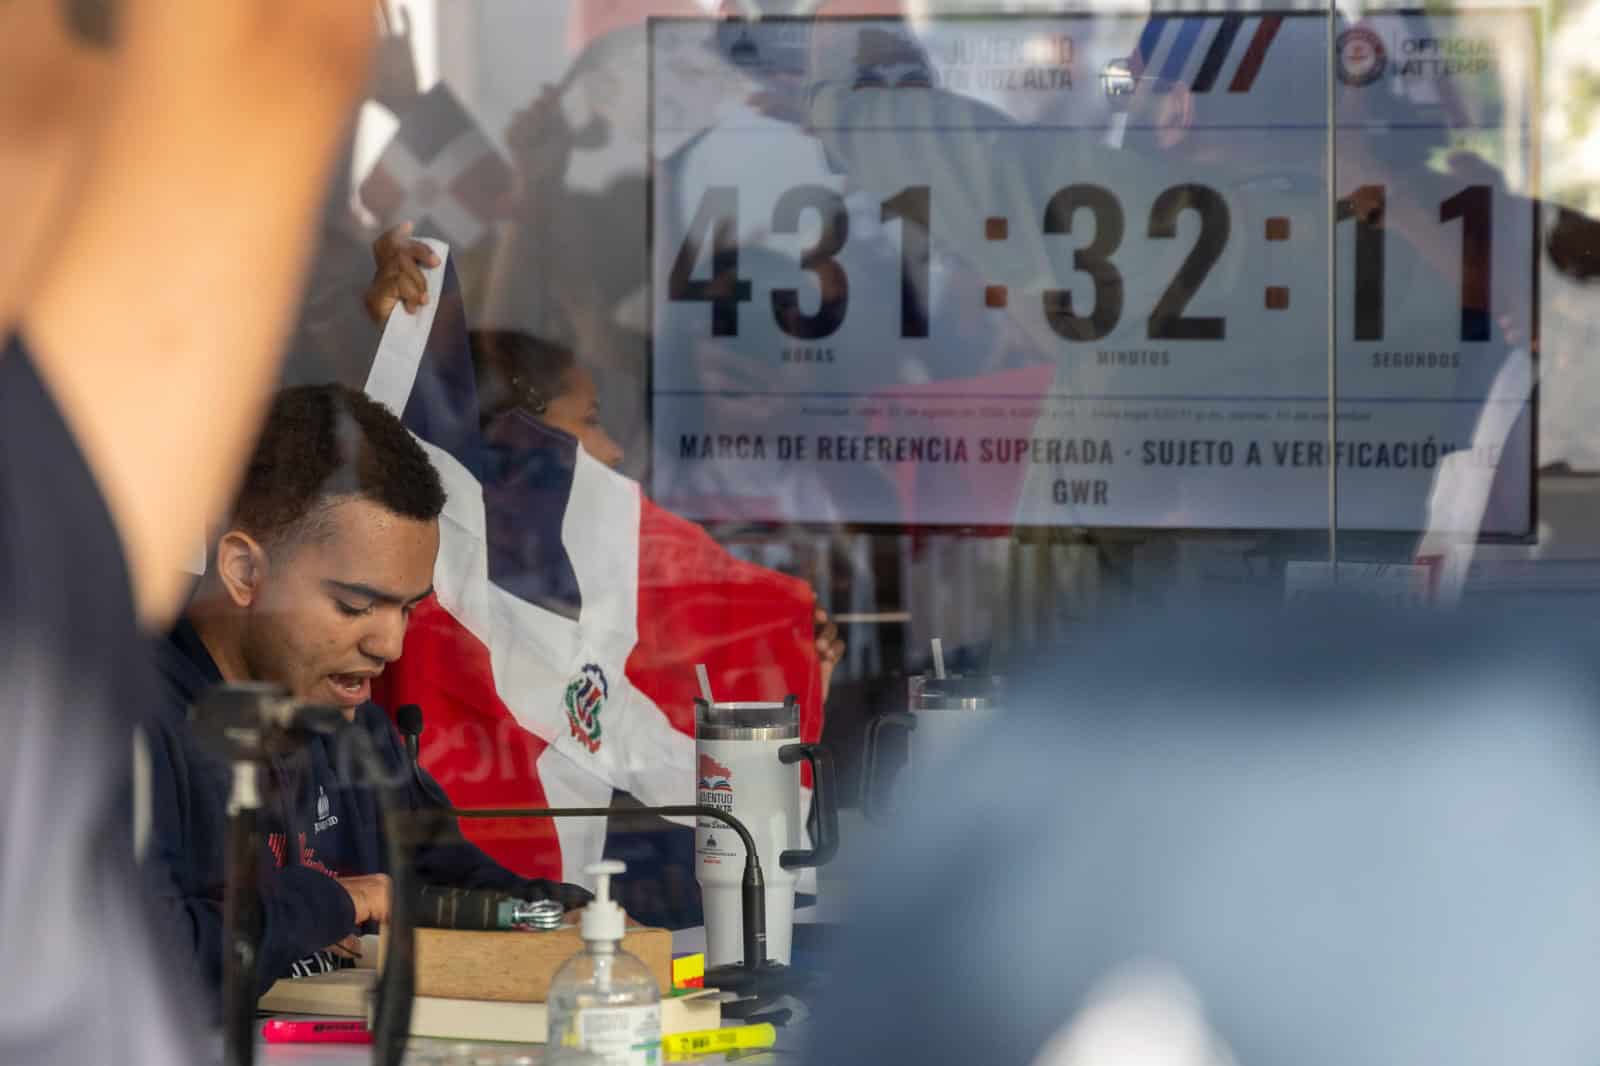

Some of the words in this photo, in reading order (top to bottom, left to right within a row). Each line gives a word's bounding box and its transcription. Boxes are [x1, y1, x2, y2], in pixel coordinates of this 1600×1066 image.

[1022, 67, 1073, 91] ALTA
[1372, 352, 1462, 369] SEGUNDOS
[680, 435, 766, 462] MARCA
[778, 436, 803, 462] DE
[818, 436, 969, 464] REFERENCIA
[980, 437, 1112, 465] SUPERADA
[1142, 439, 1234, 467] SUJETO
[1246, 441, 1263, 467] A
[1052, 479, 1109, 506] GWR
